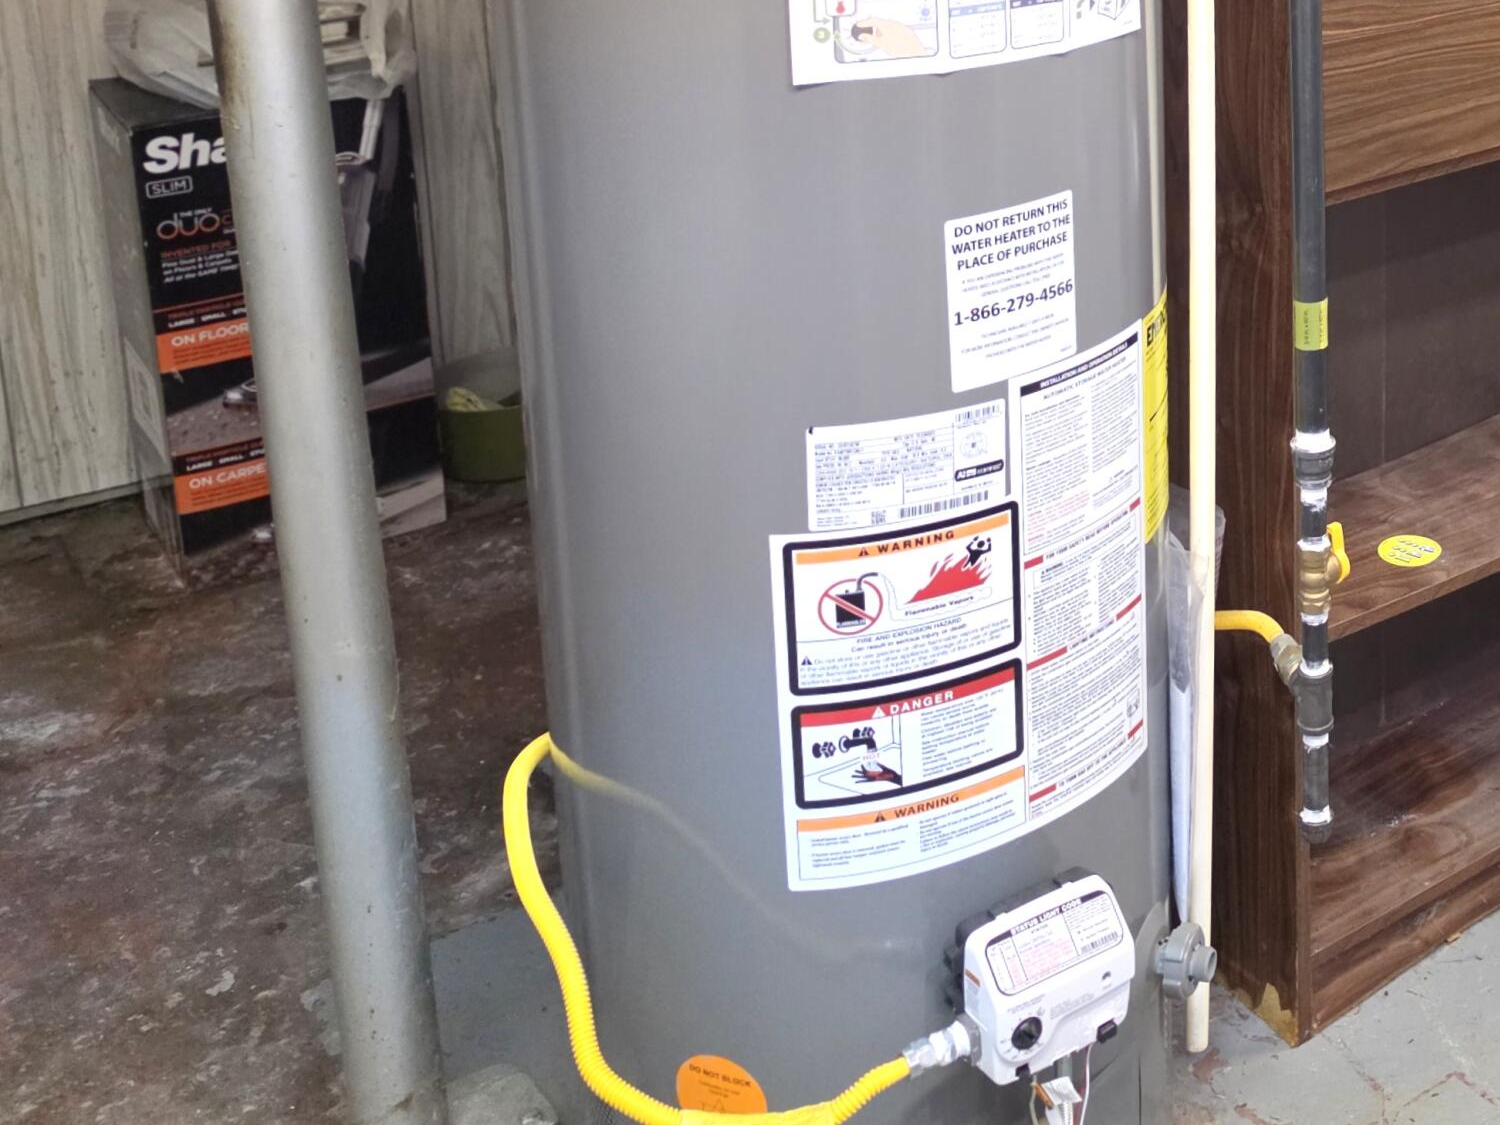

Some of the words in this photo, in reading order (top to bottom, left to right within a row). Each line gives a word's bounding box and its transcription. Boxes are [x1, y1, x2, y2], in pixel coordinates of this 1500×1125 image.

[152, 180, 187, 195] SLIM
[954, 225, 973, 238] DO
[976, 219, 1000, 233] NOT
[1002, 206, 1044, 227] RETURN
[1046, 199, 1068, 214] THIS
[952, 237, 992, 255] WATER
[994, 226, 1035, 245] HEATER
[1037, 221, 1051, 233] TO
[1052, 214, 1071, 228] THE
[957, 253, 994, 271] PLACE
[997, 249, 1012, 262] OF
[1014, 231, 1068, 256] PURCHASE
[954, 279, 1073, 326] 1-866-279-4566
[171, 335, 196, 347] ON
[188, 476, 212, 489] ON
[877, 530, 955, 553] WARNING
[890, 691, 954, 715] DANGER
[894, 794, 960, 819] WARNING
[689, 1063, 701, 1074] DO
[703, 1068, 720, 1080] NOT
[721, 1074, 752, 1088] BLOCK
